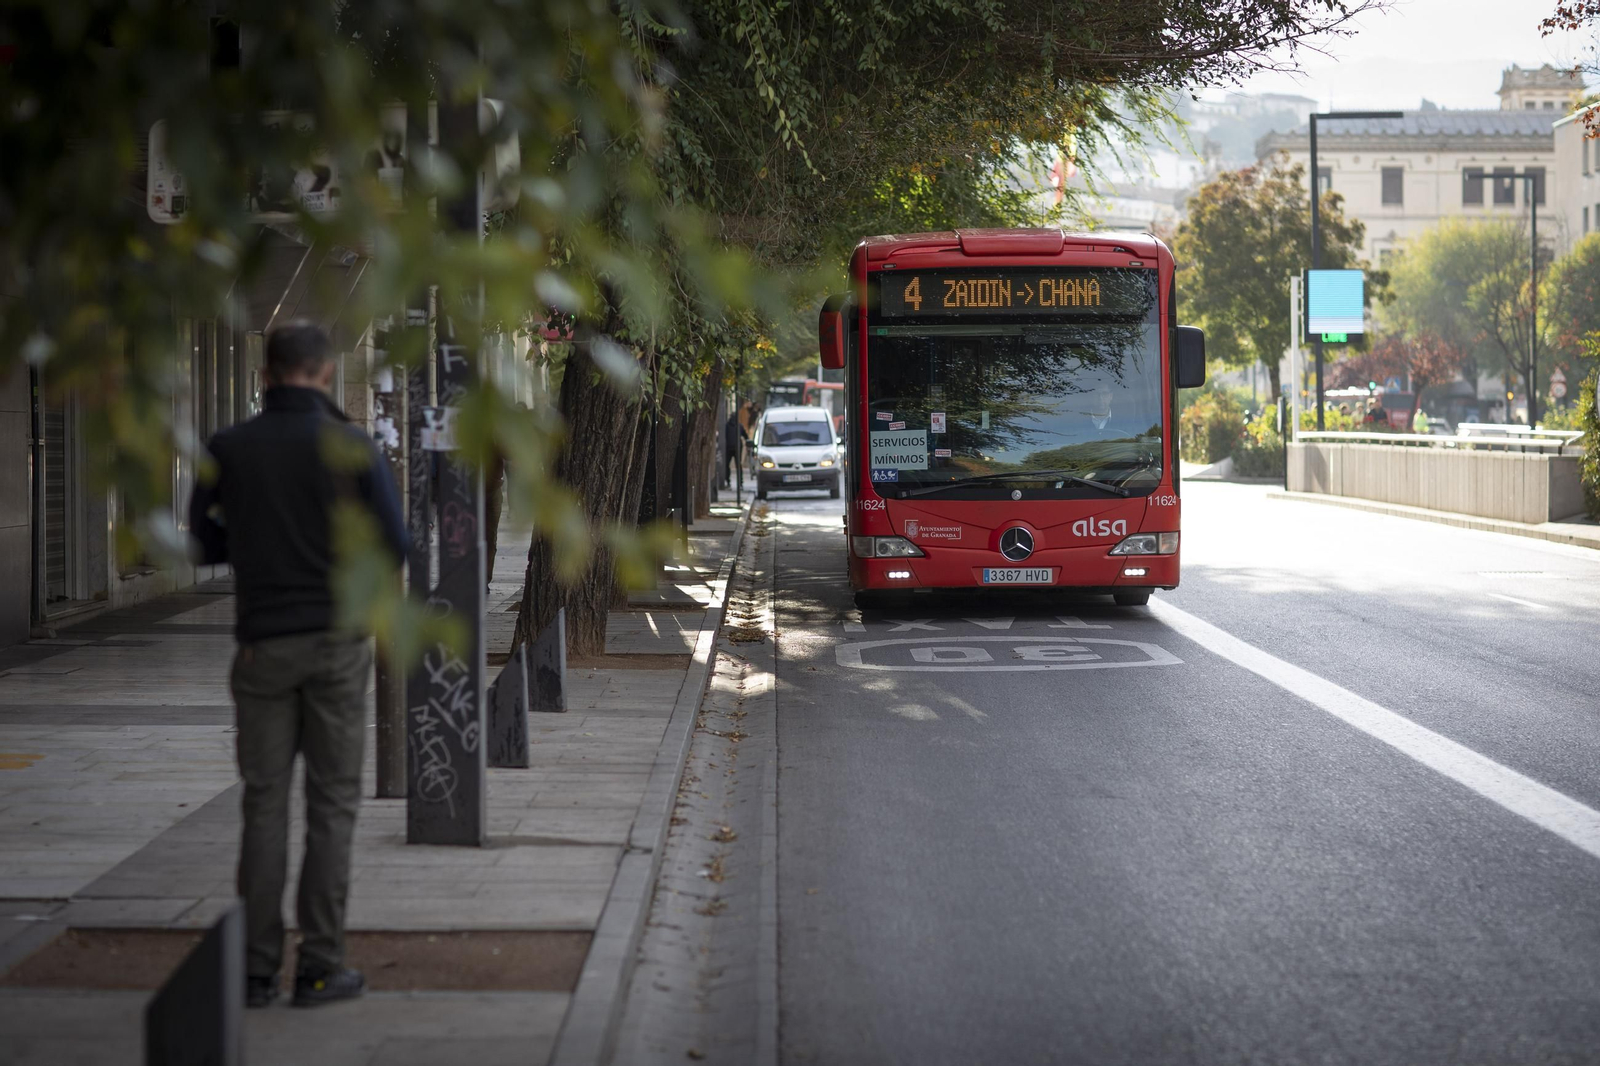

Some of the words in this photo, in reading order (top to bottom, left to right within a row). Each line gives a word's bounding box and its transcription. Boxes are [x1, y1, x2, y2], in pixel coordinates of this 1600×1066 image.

[904, 276, 922, 311] 4
[943, 279, 1011, 307] ZAIDIN
[1039, 278, 1100, 306] CHANA
[872, 437, 925, 448] SERVICIOS
[875, 453, 925, 465] MÍNIMOS
[855, 500, 886, 511] 11624
[1147, 495, 1177, 506] 11624
[1072, 516, 1127, 537] alsa
[990, 570, 1021, 582] 3367
[1025, 570, 1049, 582] HVD
[842, 616, 1113, 632] TAXI
[909, 645, 1102, 663] 30
